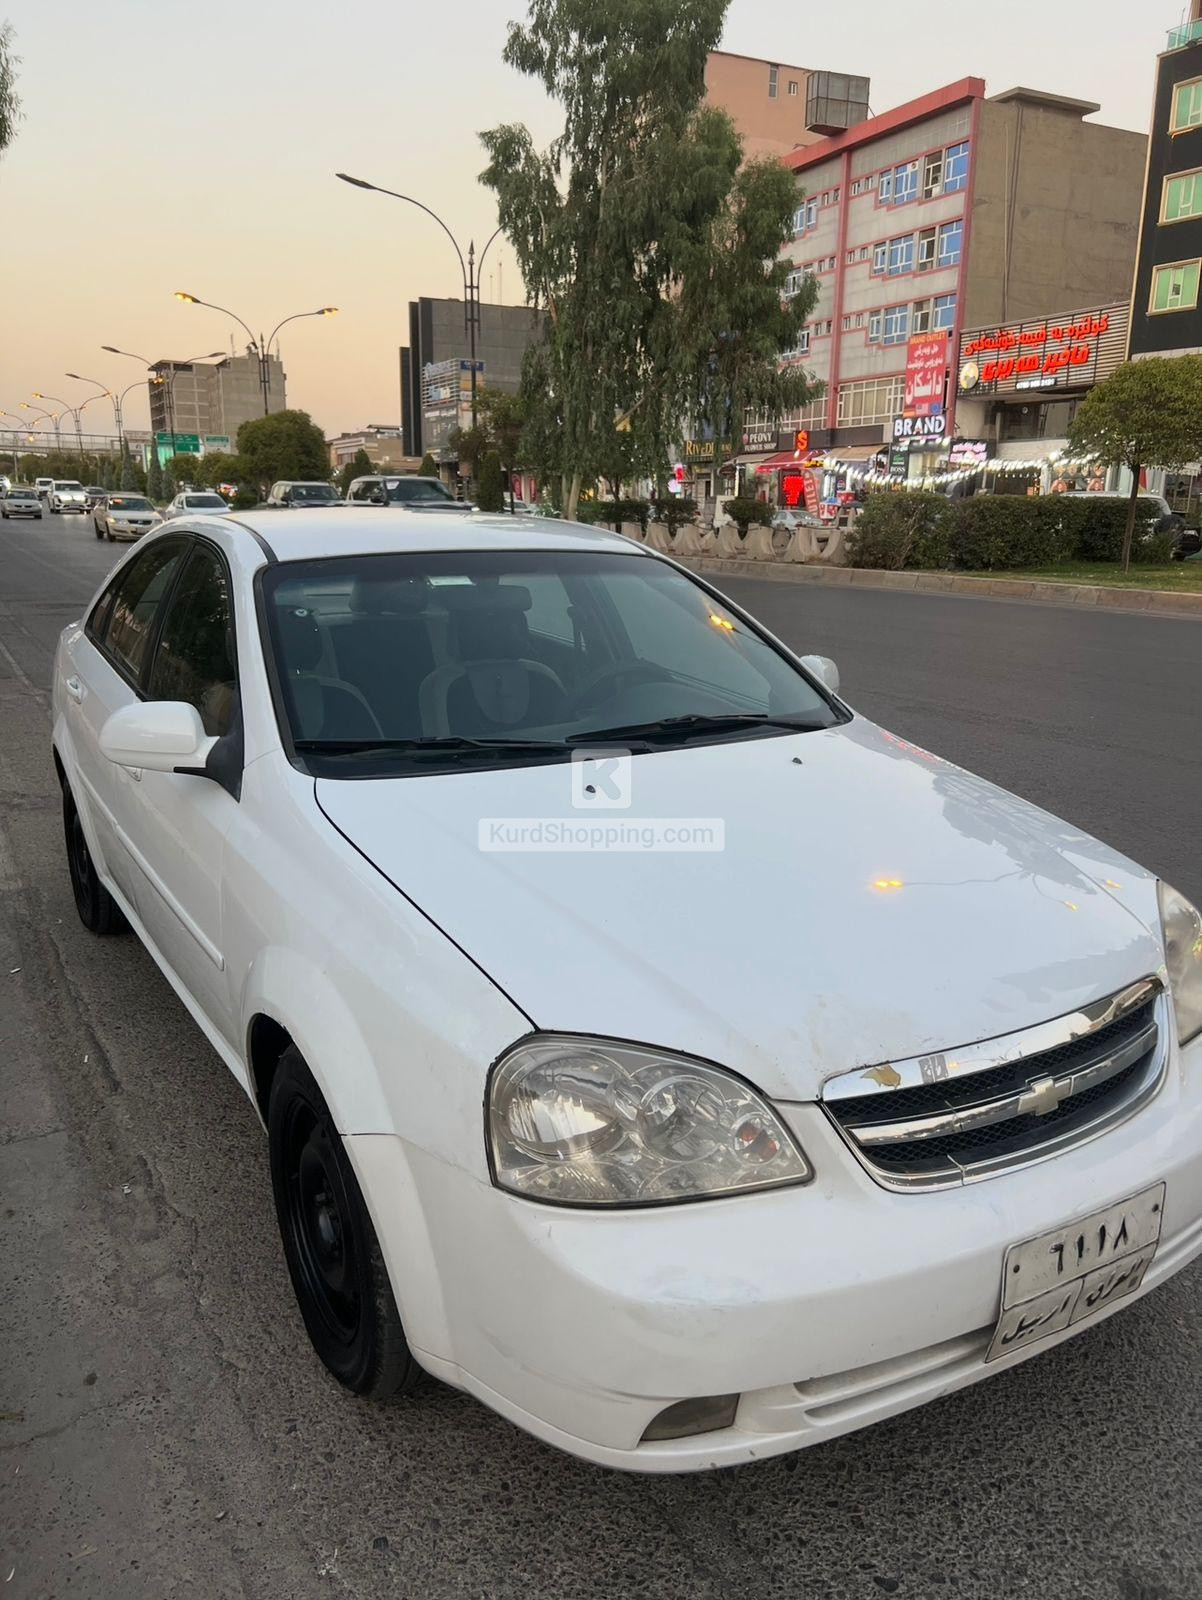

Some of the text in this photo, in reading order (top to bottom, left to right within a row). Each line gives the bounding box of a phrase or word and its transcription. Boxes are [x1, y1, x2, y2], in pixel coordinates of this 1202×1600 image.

[894, 416, 945, 436] BRAND
[750, 432, 773, 443] PEONY
[1050, 1214, 1129, 1275] ٦١١٨
